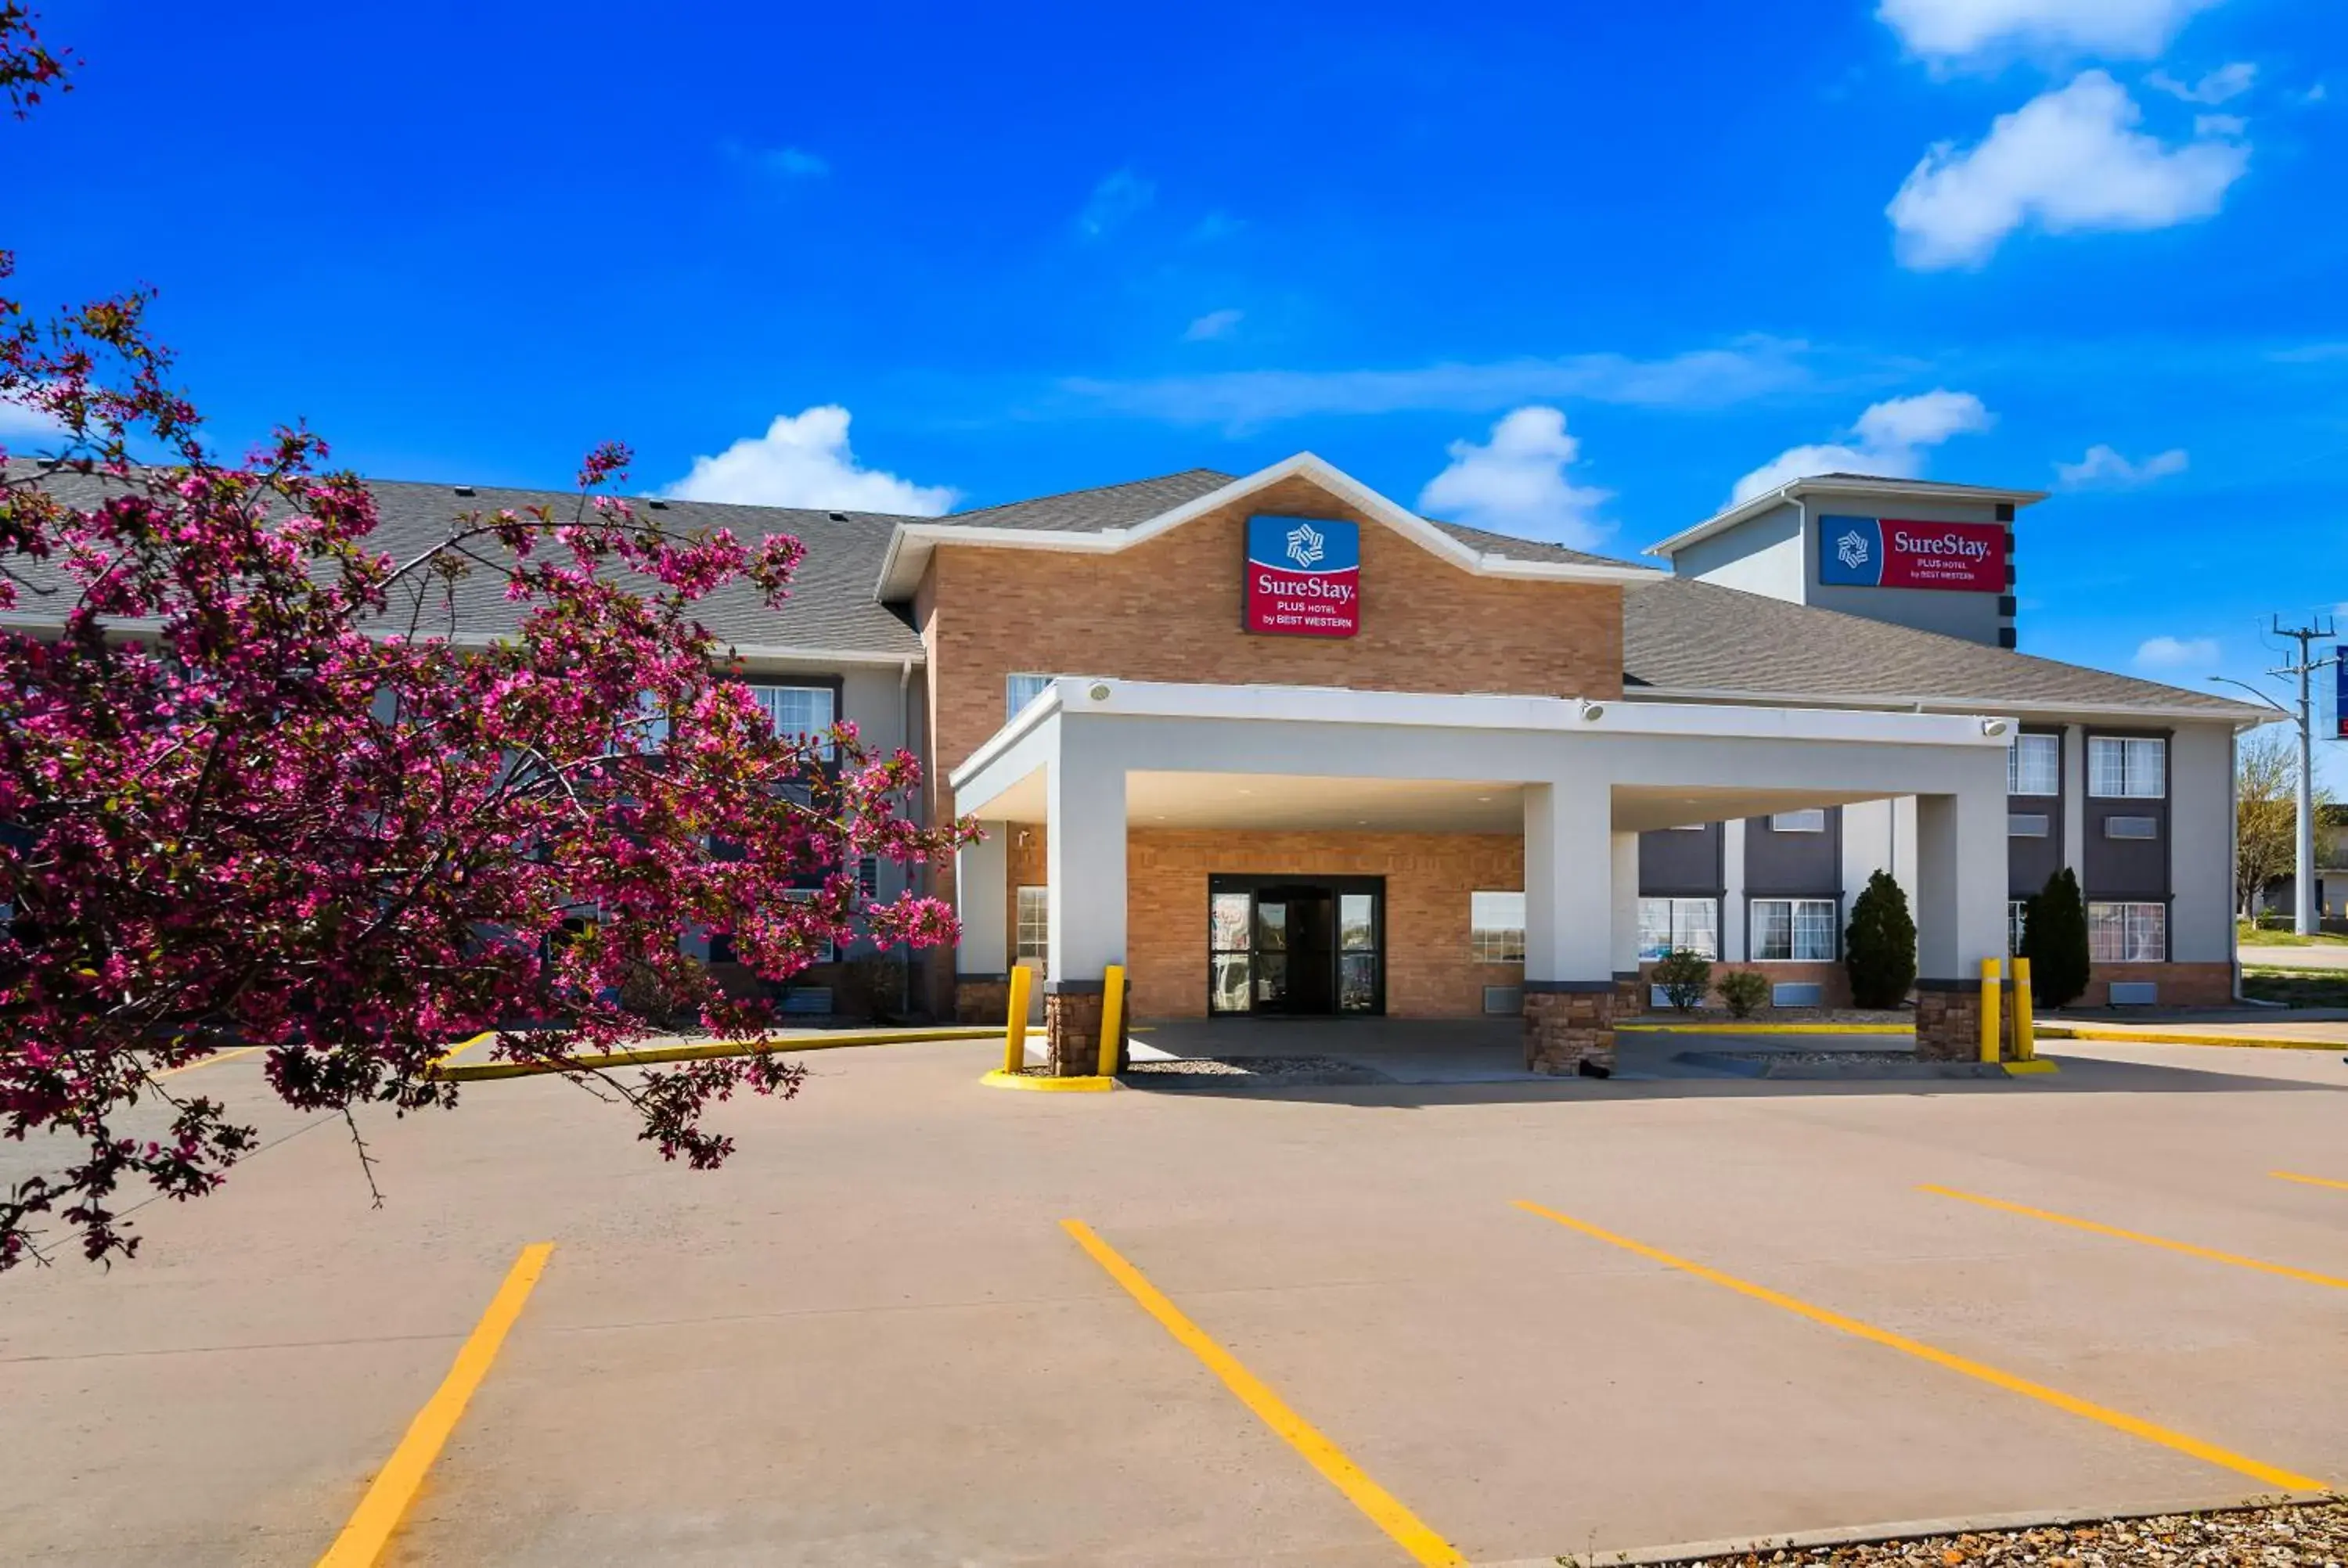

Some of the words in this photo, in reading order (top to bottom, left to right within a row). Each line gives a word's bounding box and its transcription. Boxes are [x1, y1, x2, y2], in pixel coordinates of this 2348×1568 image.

[1917, 558, 1941, 568] PLUS
[1942, 561, 1968, 570] HOTEL
[1277, 601, 1305, 612] PLUS
[1308, 605, 1337, 613] HOTEL
[1263, 615, 1275, 625] by
[1277, 615, 1303, 624] BEST
[1305, 616, 1352, 628] WESTERN
